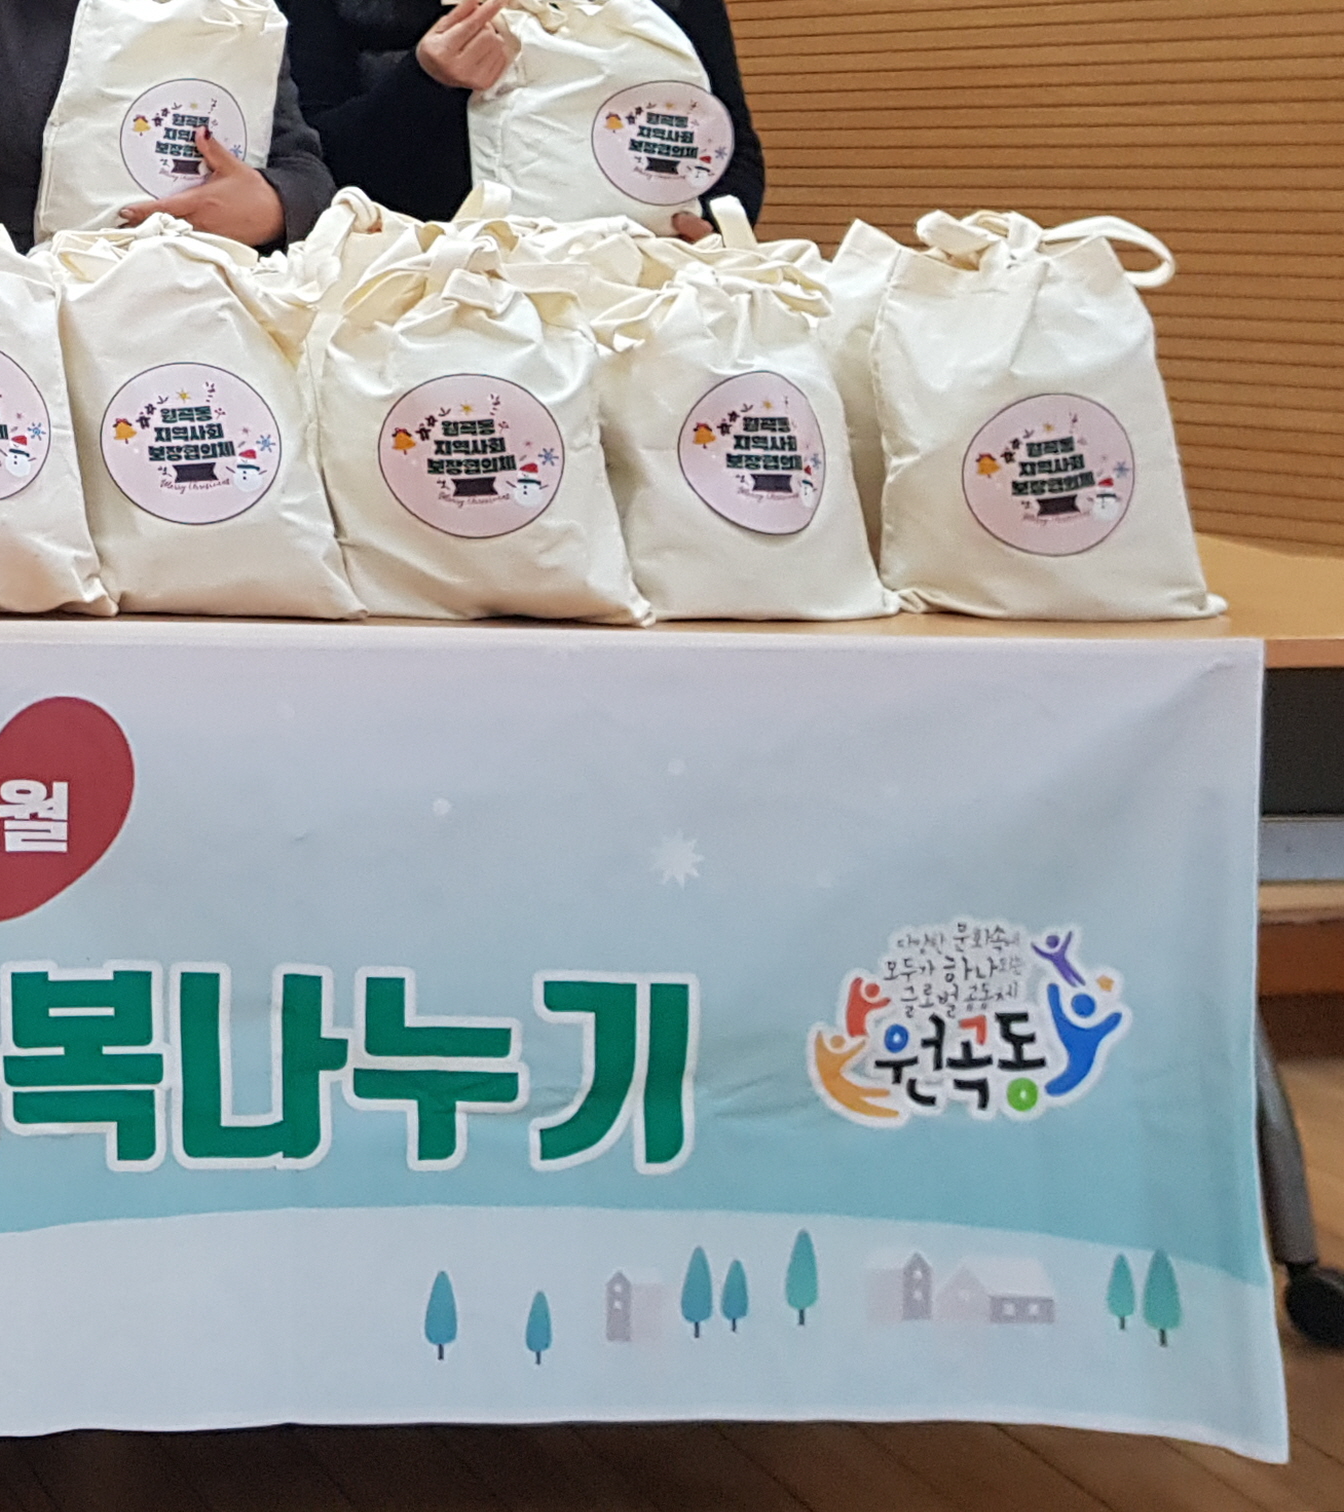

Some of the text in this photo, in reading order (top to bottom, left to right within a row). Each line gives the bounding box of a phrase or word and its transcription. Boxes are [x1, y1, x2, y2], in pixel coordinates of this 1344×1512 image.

[163, 127, 196, 143] 지역
[160, 406, 212, 423] 원곡동
[154, 423, 224, 442] 지역사회
[148, 441, 236, 461] 보장협의체
[883, 958, 935, 982] 모두가
[900, 981, 1018, 1018] 글로벌 공동체
[874, 1012, 1047, 1112] 원곡동
